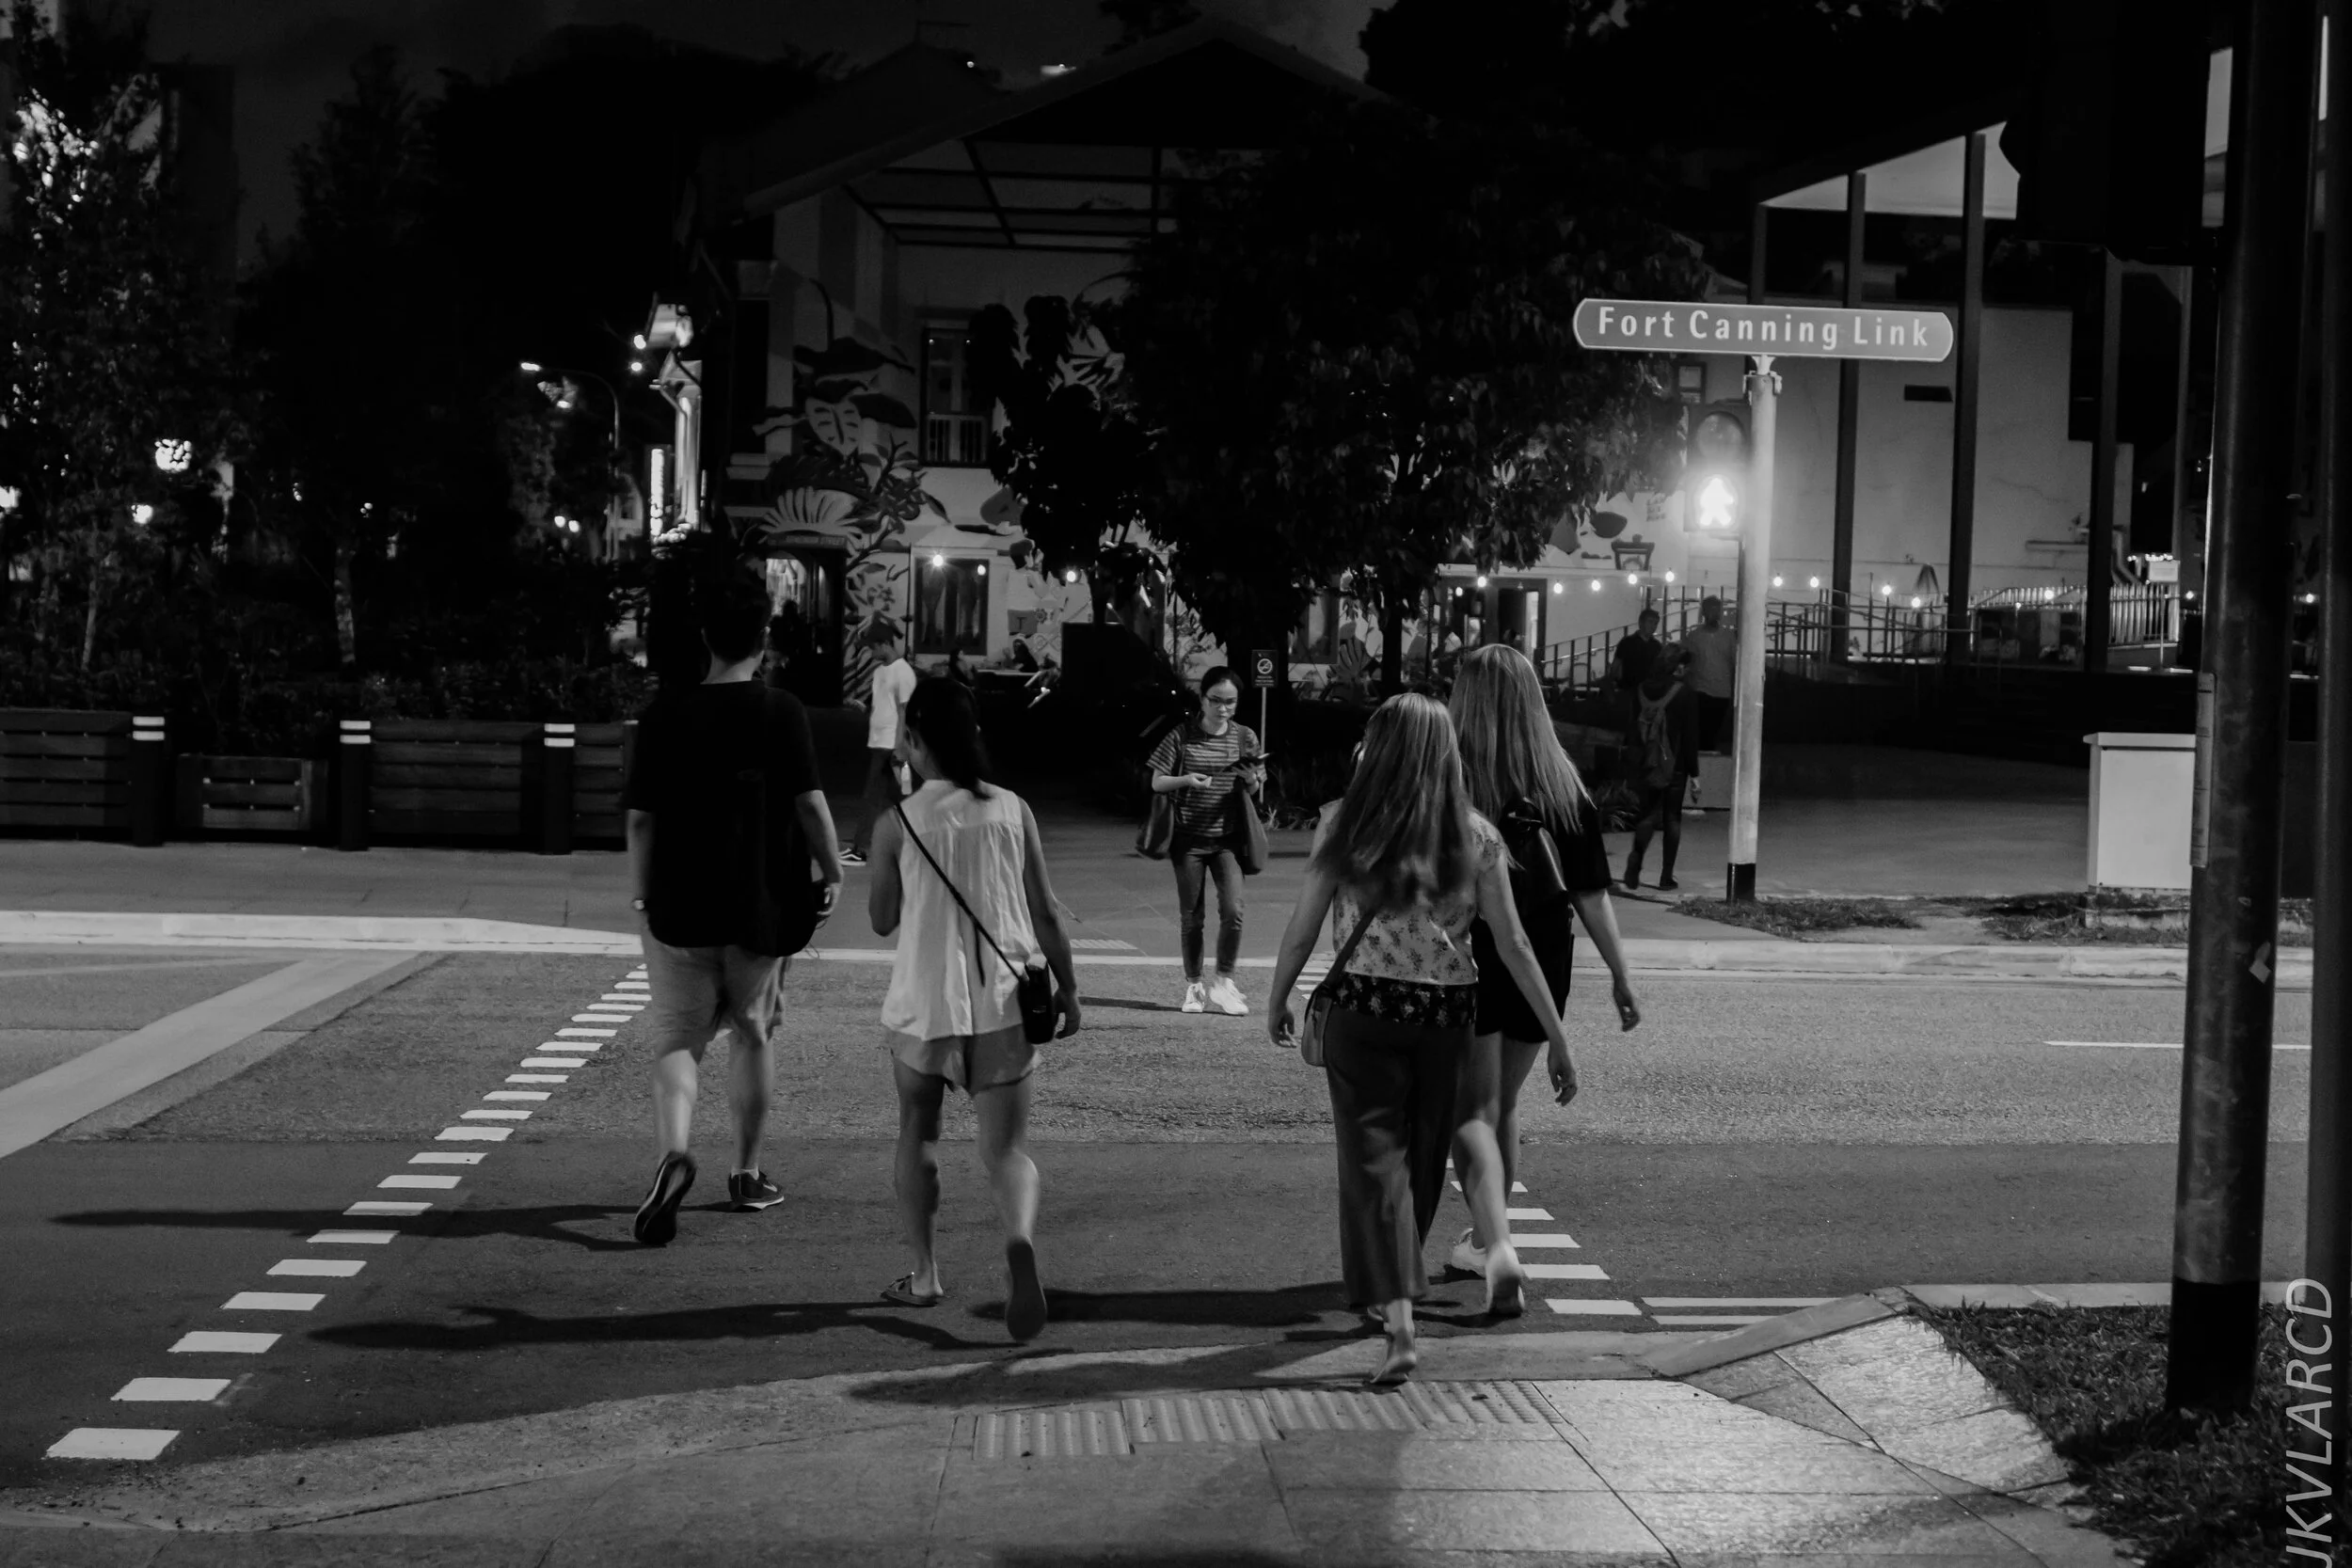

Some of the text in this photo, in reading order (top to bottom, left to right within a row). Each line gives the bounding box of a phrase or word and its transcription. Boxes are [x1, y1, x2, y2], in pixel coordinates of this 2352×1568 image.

[1598, 307, 1929, 350] Fort Canning Link
